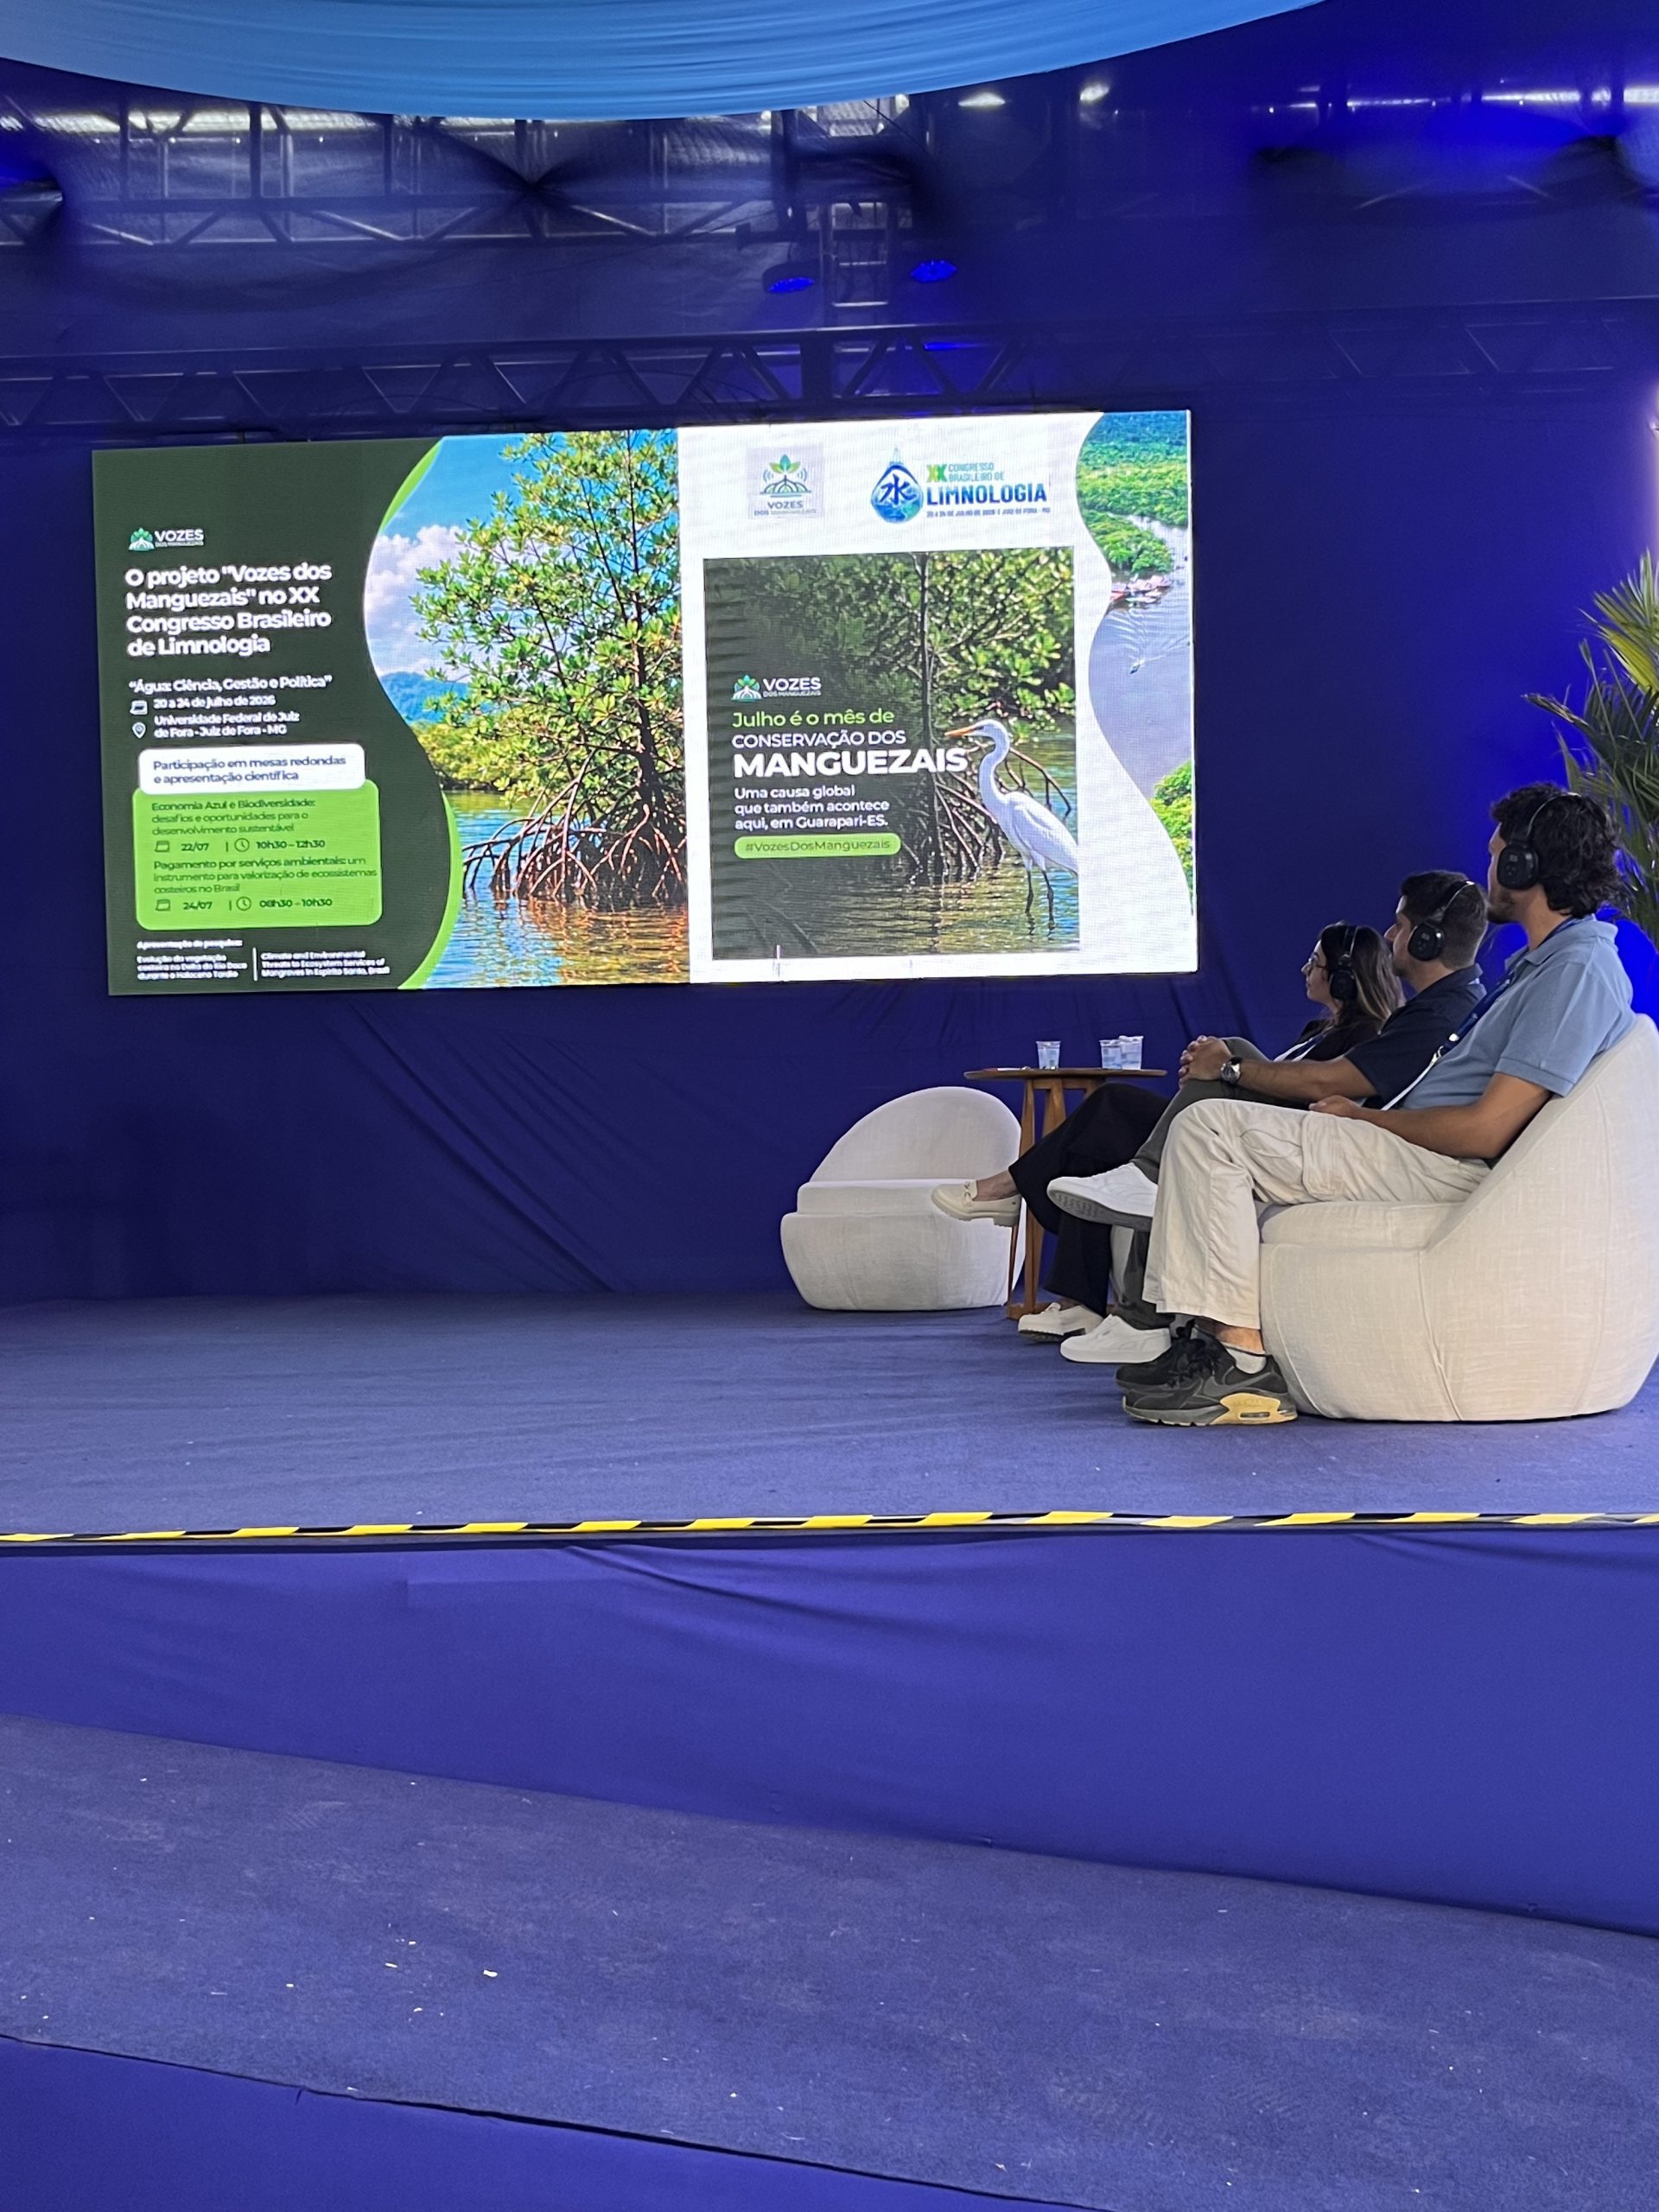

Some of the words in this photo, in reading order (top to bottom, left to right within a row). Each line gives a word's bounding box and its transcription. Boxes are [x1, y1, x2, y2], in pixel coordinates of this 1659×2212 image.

[948, 462, 995, 473] CONGRESSO
[926, 483, 1047, 505] LIMNOLOGIA
[767, 500, 804, 510] VOZES
[155, 529, 204, 542] VOZES
[125, 569, 144, 587] O
[147, 566, 220, 589] projeto
[293, 562, 332, 581] dos
[126, 587, 256, 612] Manguezais"
[258, 590, 287, 605] no
[288, 586, 320, 603] XX
[127, 615, 234, 635] Congresso
[237, 608, 332, 629] Brasileiro
[127, 639, 156, 657] de
[158, 633, 271, 656] Limnologia
[223, 677, 268, 690] Gestão
[269, 678, 278, 689] e
[763, 677, 821, 691] VOZES
[153, 698, 168, 709] 20
[176, 697, 190, 709] 24
[191, 697, 206, 708] de
[234, 696, 248, 706] de
[154, 715, 221, 726] Universidade
[222, 712, 262, 723] Federal
[263, 711, 277, 722] de
[278, 710, 300, 722] Juiz
[733, 711, 786, 728] Julho
[790, 710, 803, 726] é
[806, 715, 819, 726] o
[823, 709, 866, 725] mês
[869, 708, 894, 724] de
[154, 728, 169, 738] de
[169, 727, 194, 738] Fora
[199, 725, 221, 737] Juiz
[222, 726, 237, 736] de
[237, 725, 261, 735] Fora
[266, 724, 288, 734] MG
[732, 728, 864, 748] CONSERVAÇÃO
[868, 730, 906, 745] DOS
[153, 759, 225, 772] Participação
[227, 760, 246, 768] em
[249, 759, 287, 768] mesas
[290, 755, 346, 766] redondas
[734, 747, 969, 779] MANGUEZAIS
[163, 772, 242, 785] apresentação
[734, 787, 767, 799] Uma
[770, 787, 810, 798] causa
[812, 785, 855, 799] global
[151, 802, 203, 811] Economia
[205, 800, 227, 810] Azul
[734, 804, 762, 815] que
[763, 799, 824, 814] também
[827, 800, 890, 812] acontece
[152, 813, 194, 823] desafios
[203, 811, 276, 823] oportunidades
[277, 812, 300, 822] para
[734, 817, 768, 831] aqui,
[771, 818, 793, 830] em
[796, 814, 888, 830] Guarapari-ES.
[181, 842, 209, 852] 22/07
[257, 840, 288, 849] 10h30
[745, 839, 891, 854] #VozesDosManguezais
[183, 900, 213, 911] 24/07
[302, 899, 333, 907] 10h30
